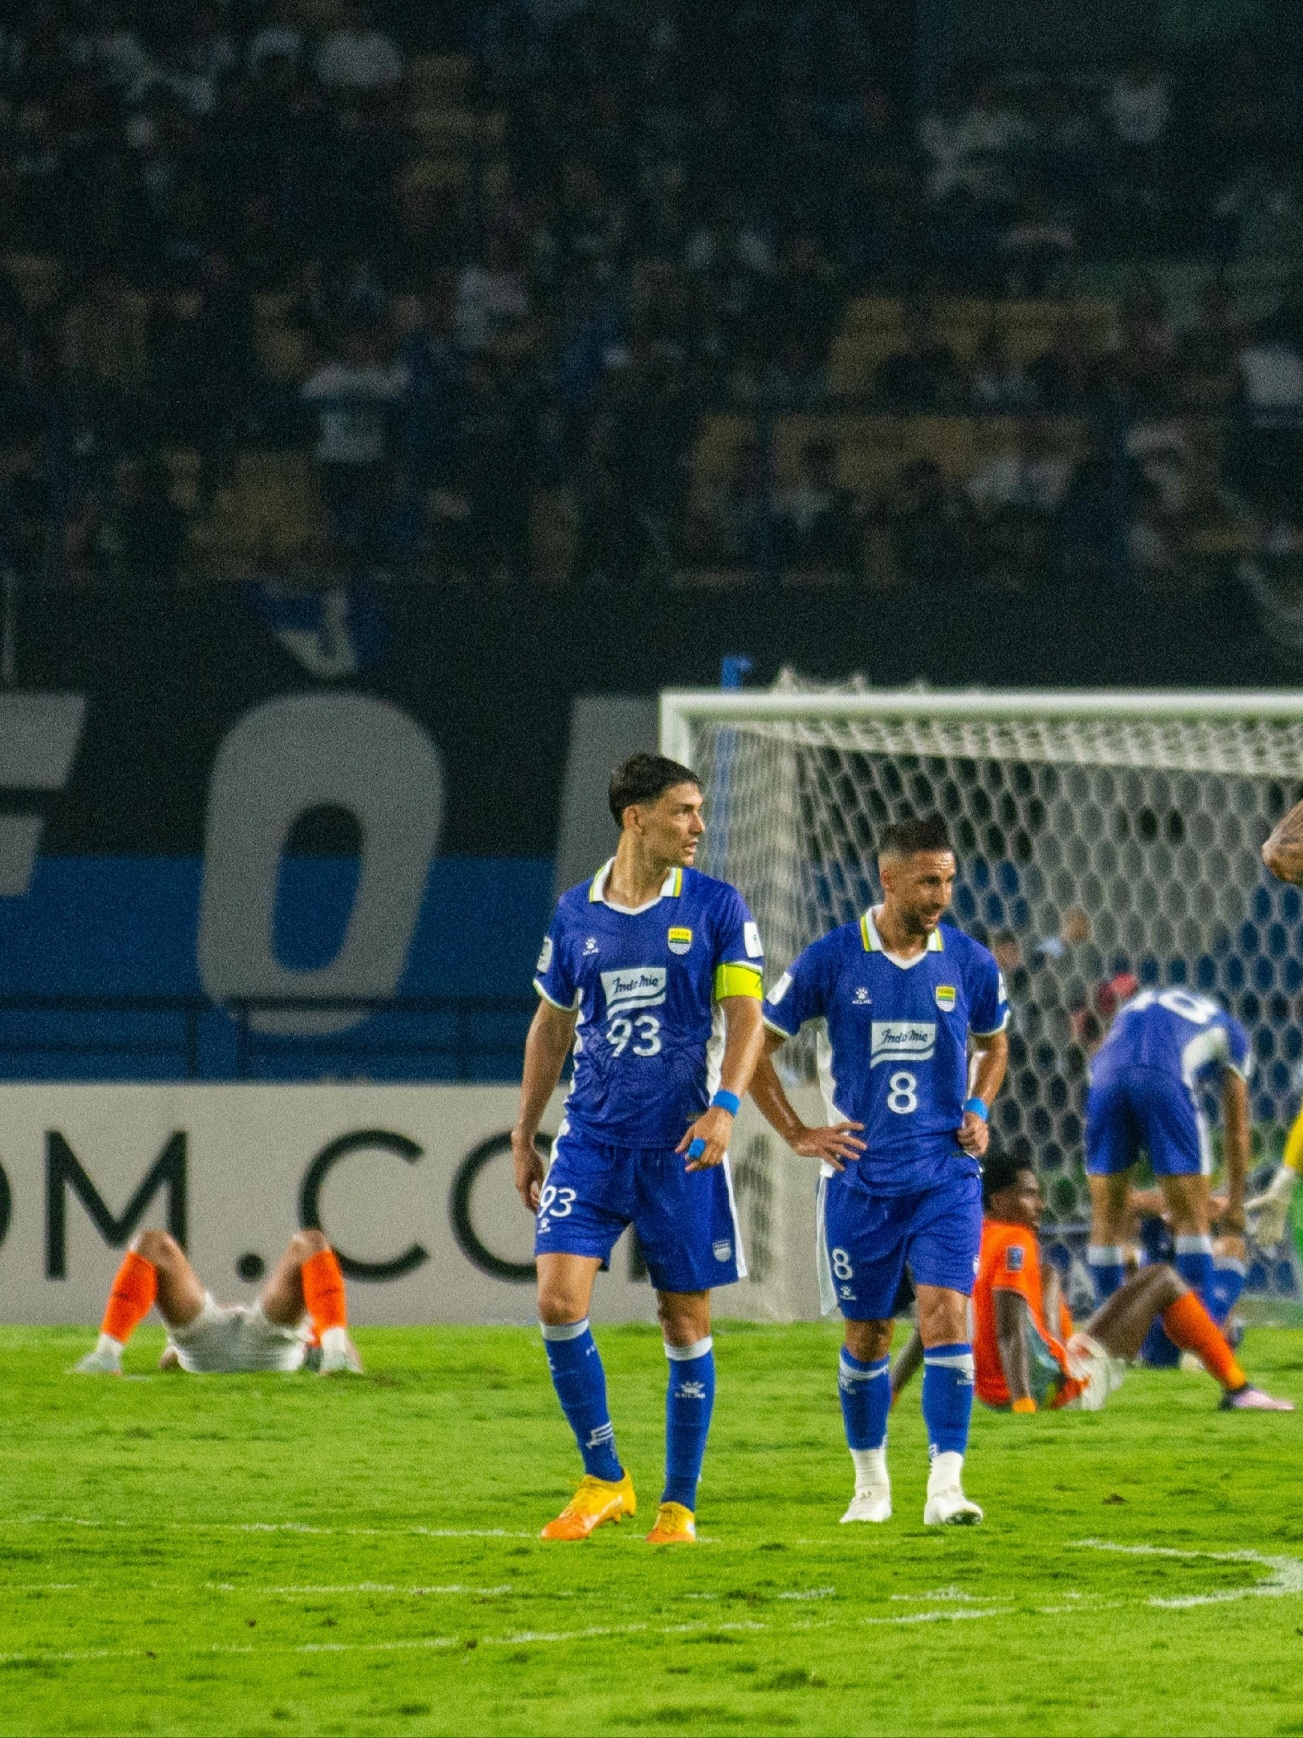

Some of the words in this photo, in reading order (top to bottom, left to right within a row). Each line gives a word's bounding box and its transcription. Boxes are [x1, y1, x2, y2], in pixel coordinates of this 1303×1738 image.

[606, 1015, 662, 1057] 93
[887, 1071, 917, 1114] 8
[538, 1185, 577, 1218] 93
[832, 1248, 853, 1280] 8
